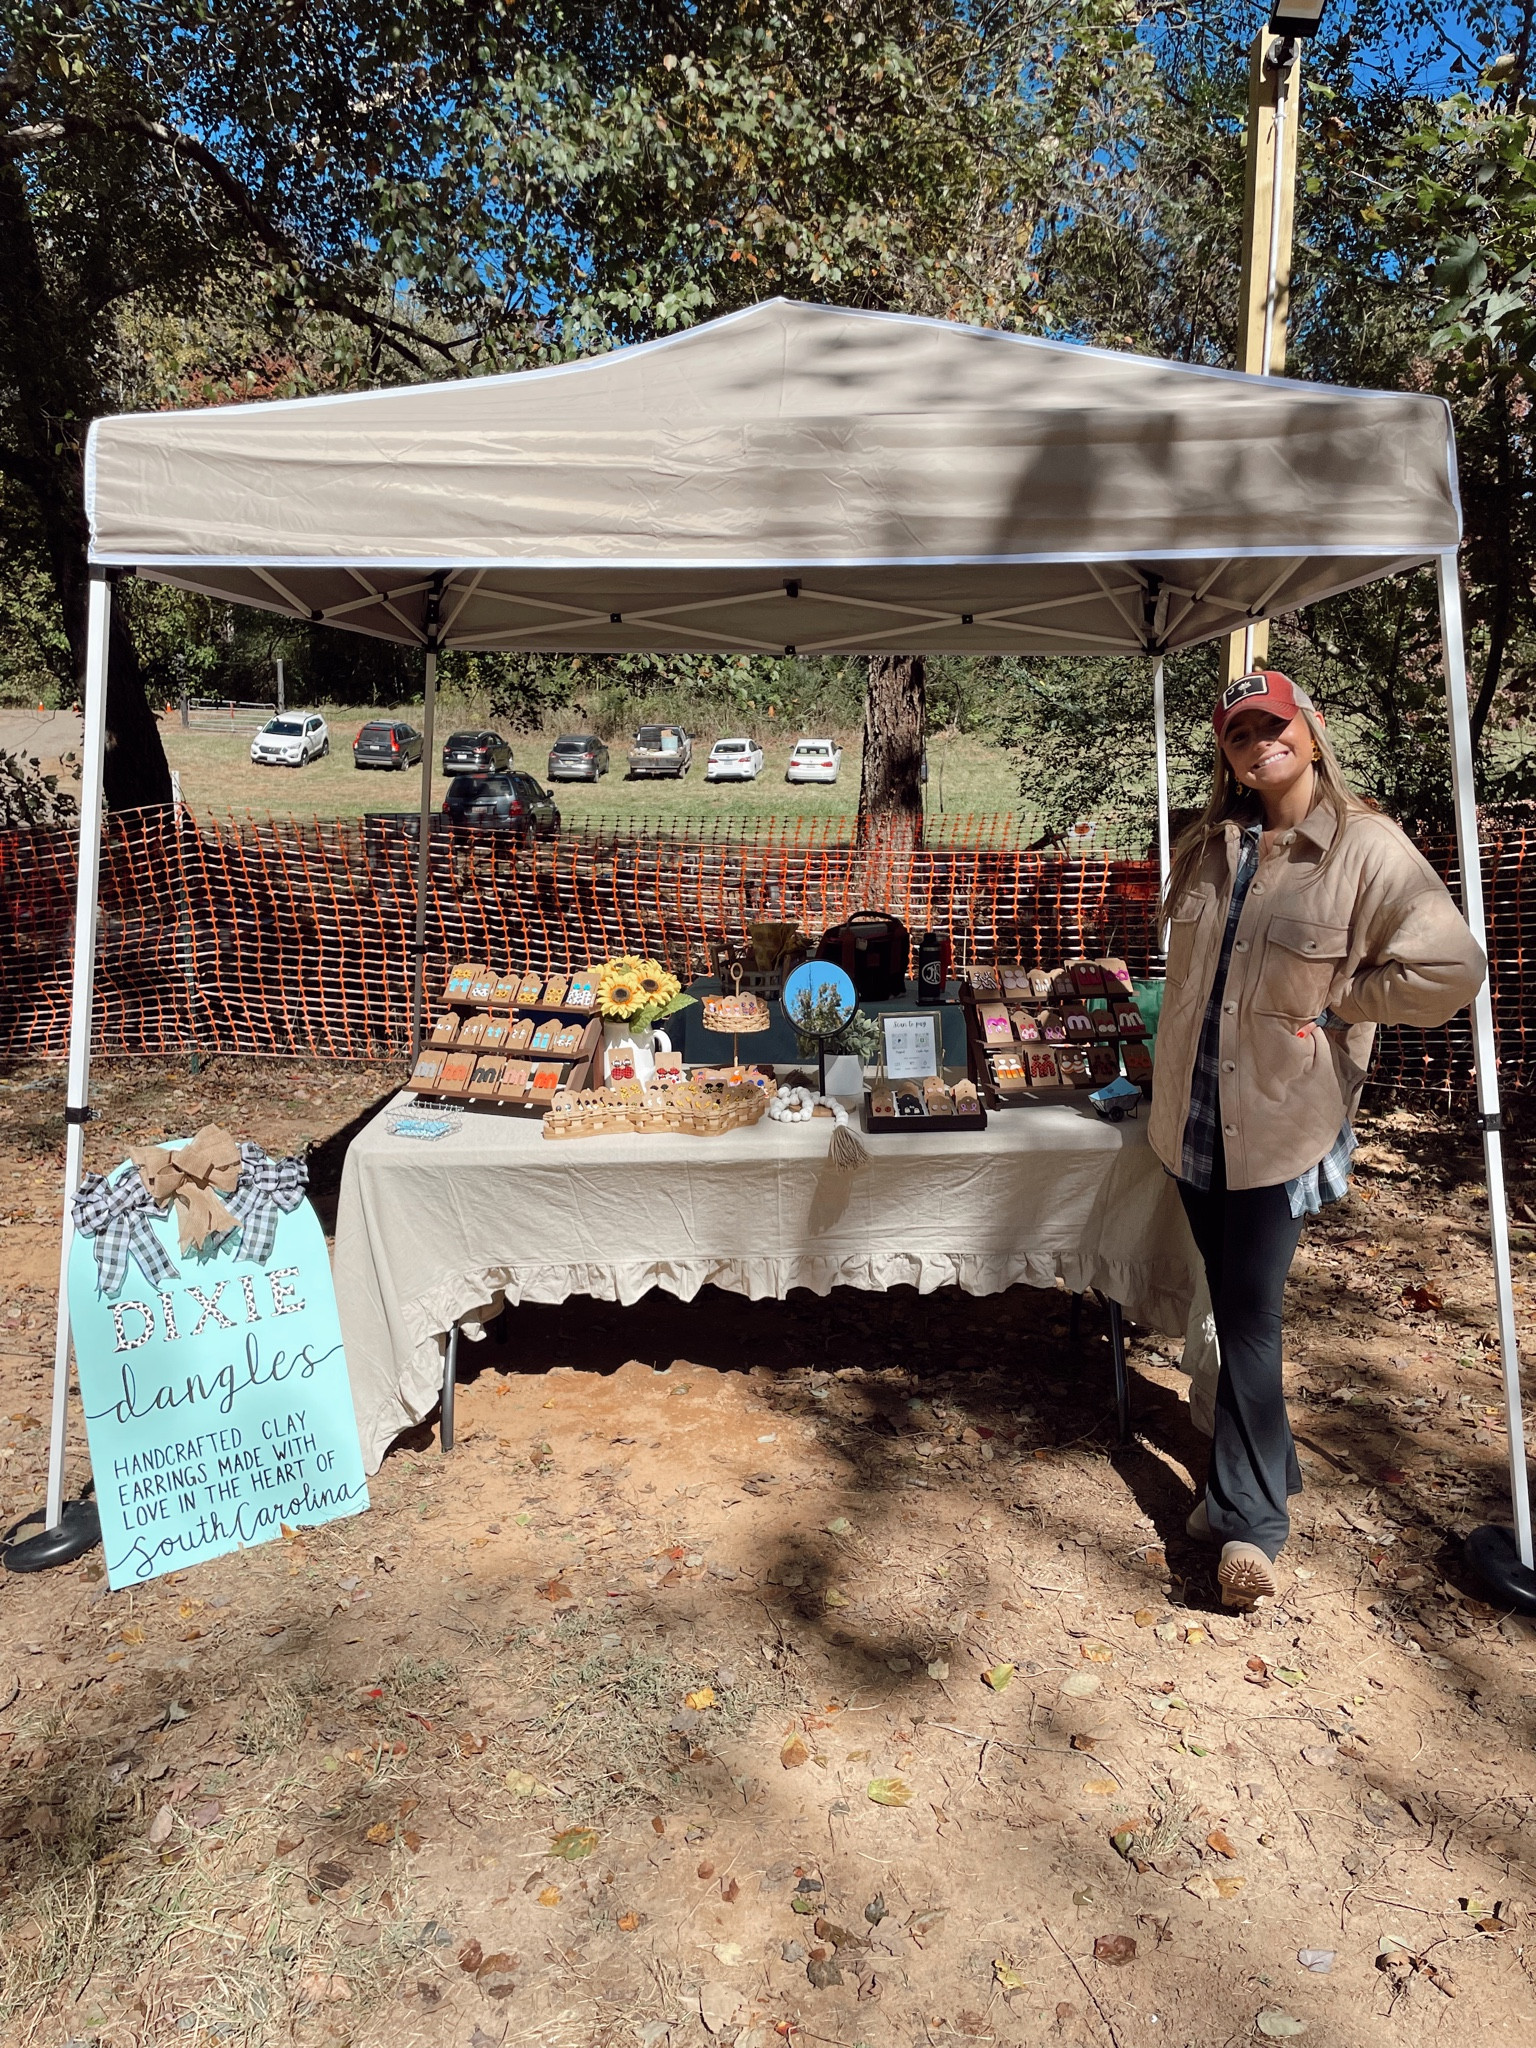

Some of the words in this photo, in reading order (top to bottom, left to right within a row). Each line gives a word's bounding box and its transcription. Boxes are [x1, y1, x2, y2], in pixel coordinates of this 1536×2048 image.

[107, 1267, 306, 1353] DIXIE
[86, 1332, 343, 1424] dangles
[114, 1427, 242, 1480] HANDCRAFTED
[262, 1410, 306, 1440] CLAY
[119, 1463, 208, 1507] EARRINGS
[218, 1446, 264, 1478] MADE
[272, 1432, 317, 1462] WITH
[123, 1498, 171, 1531] LOVE
[179, 1490, 197, 1514] IN
[205, 1477, 241, 1505] THE
[250, 1458, 306, 1492] HEART
[317, 1450, 336, 1473] OF
